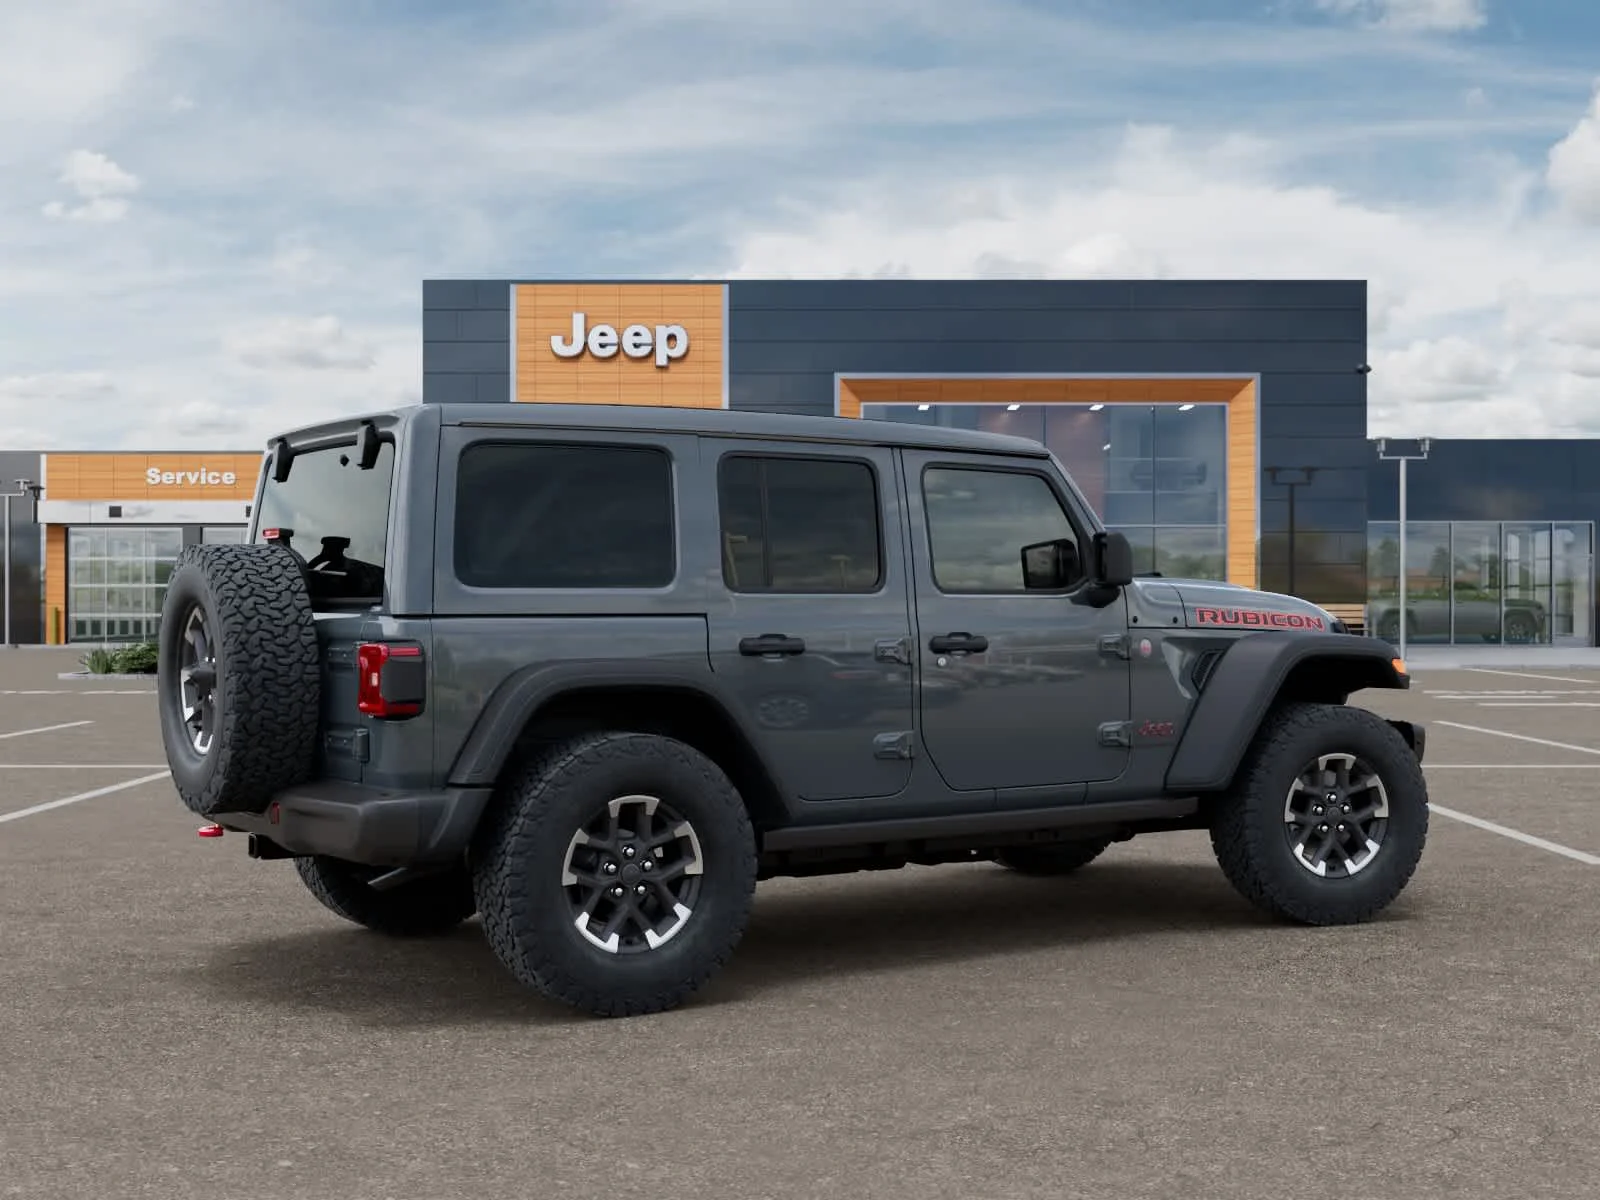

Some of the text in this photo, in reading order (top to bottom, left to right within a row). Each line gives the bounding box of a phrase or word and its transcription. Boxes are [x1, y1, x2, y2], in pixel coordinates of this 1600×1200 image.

[550, 312, 689, 367] Jeep
[146, 467, 236, 485] Service
[1196, 607, 1325, 632] RUBICON
